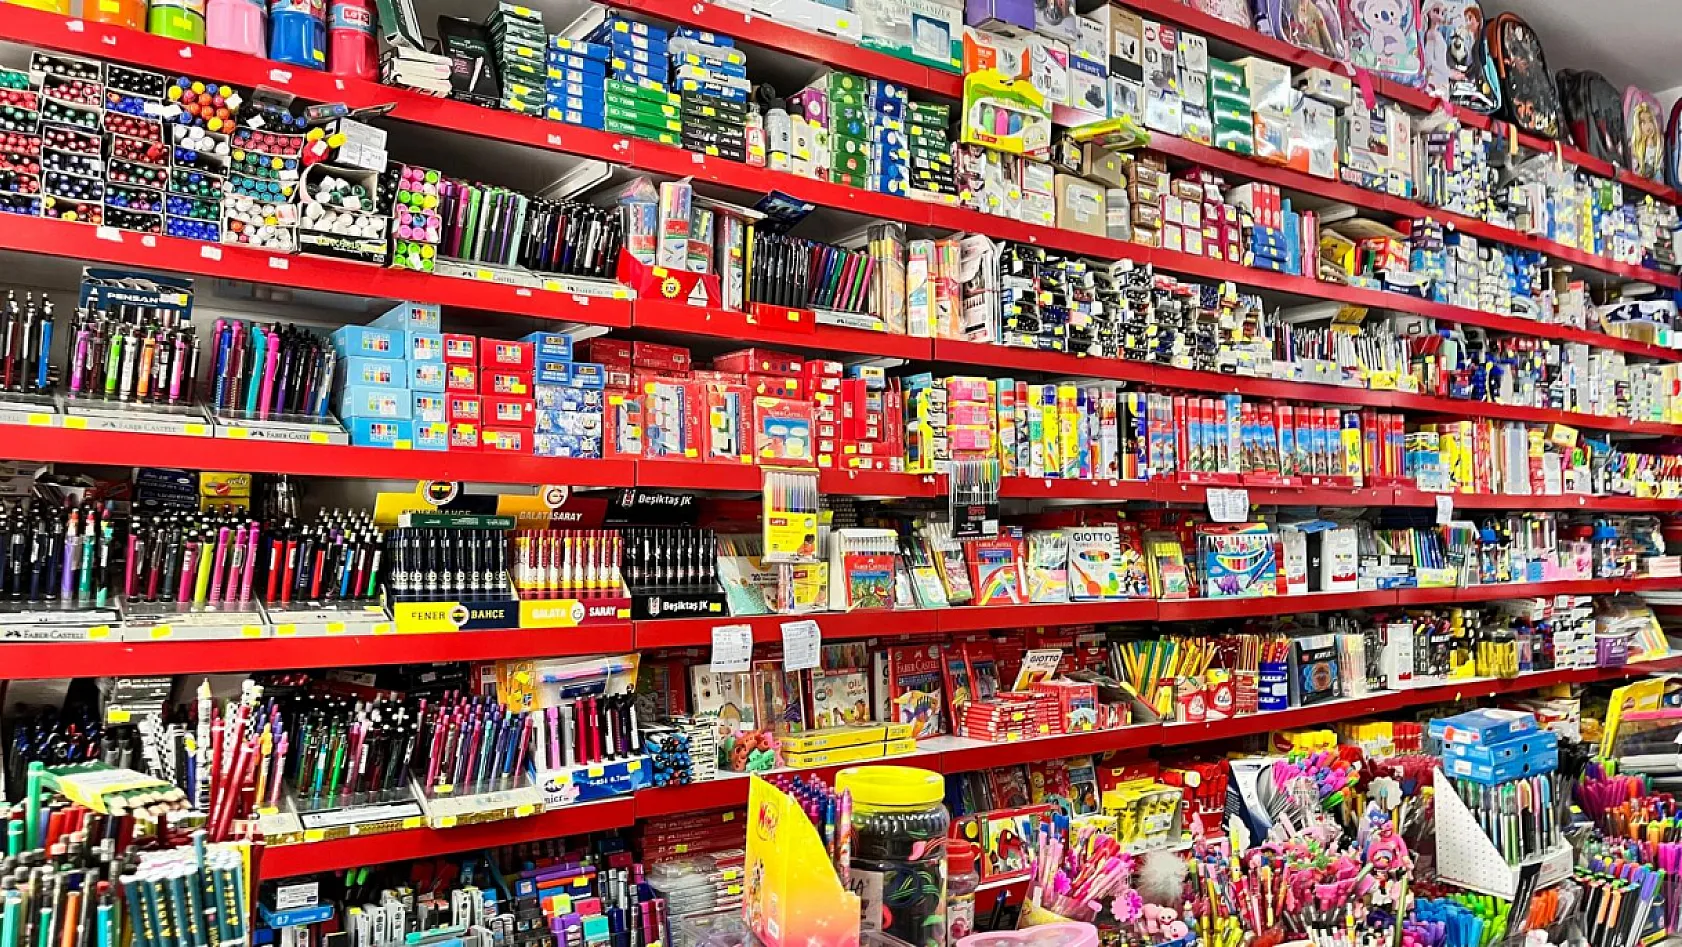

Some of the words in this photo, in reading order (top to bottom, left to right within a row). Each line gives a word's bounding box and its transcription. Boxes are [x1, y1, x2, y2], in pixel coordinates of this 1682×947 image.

[107, 292, 158, 303] PENSAN
[637, 493, 679, 506] Beşiktaş
[519, 511, 582, 521] GALATASARAY
[1073, 532, 1112, 542] GIOTTO
[590, 606, 616, 617] SARAY
[663, 601, 698, 612] Beşiktaş
[412, 611, 445, 620] FENER
